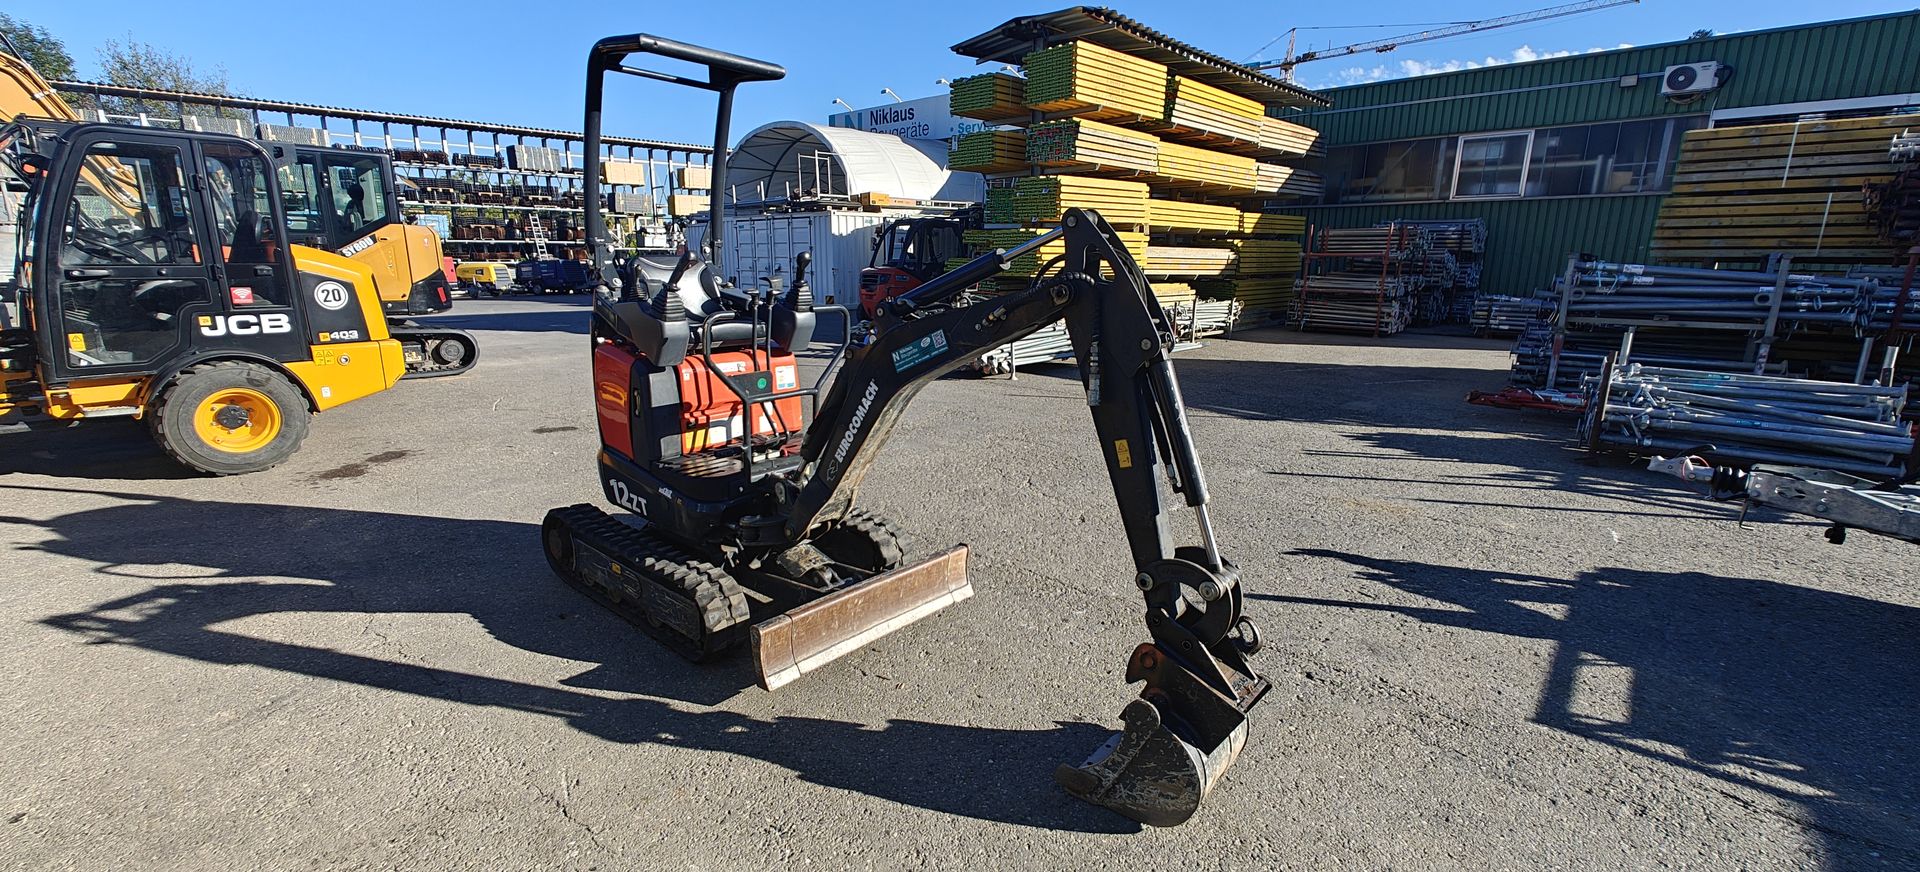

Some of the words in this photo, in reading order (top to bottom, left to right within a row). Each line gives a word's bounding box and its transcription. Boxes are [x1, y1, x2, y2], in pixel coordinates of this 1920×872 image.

[870, 107, 915, 126] Niklaus
[342, 236, 374, 257] SY80U
[321, 288, 342, 303] 20
[200, 314, 292, 337] JCB
[330, 330, 358, 339] 403
[834, 380, 879, 464] EUROCOMACH
[609, 478, 647, 516] 12ZT
